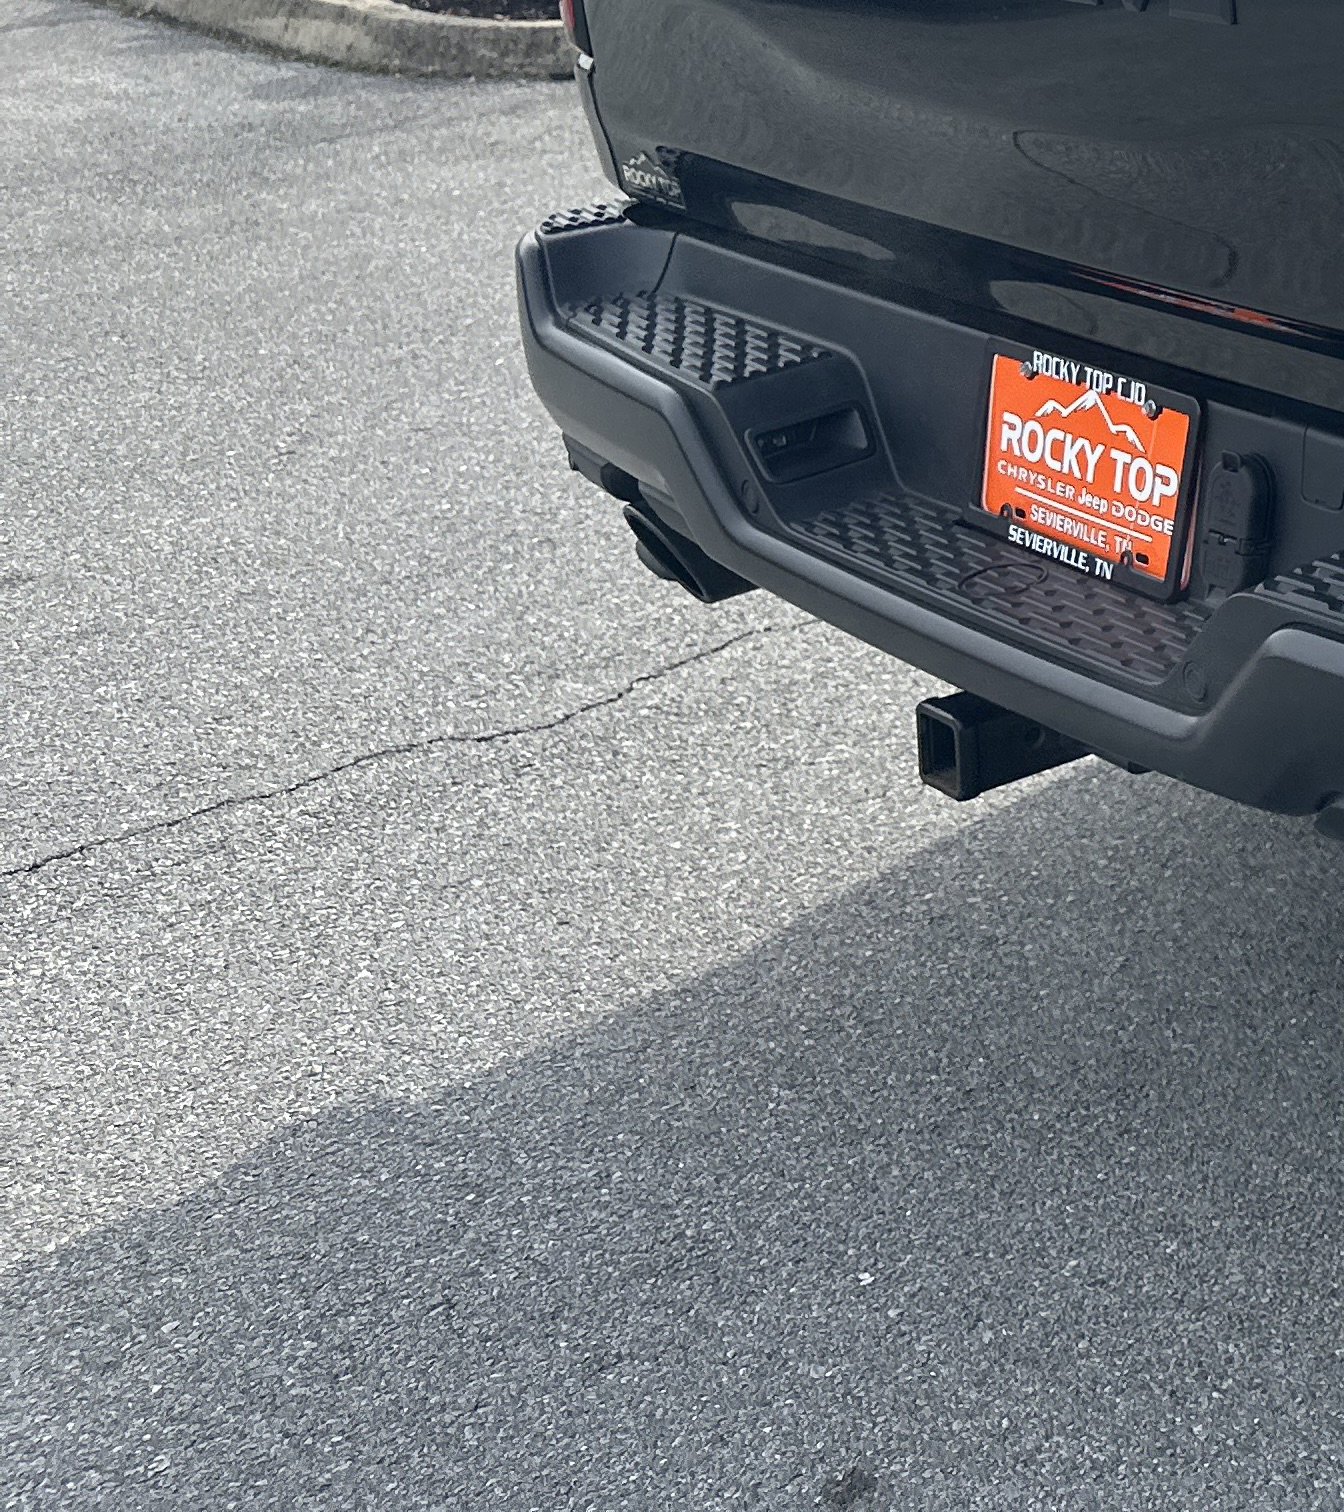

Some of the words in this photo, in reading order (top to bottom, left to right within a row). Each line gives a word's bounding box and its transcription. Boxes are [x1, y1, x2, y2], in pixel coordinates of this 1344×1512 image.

[1032, 350, 1081, 386] ROCKY
[1083, 366, 1113, 392] TOP
[1116, 376, 1147, 406] CJD
[1000, 411, 1106, 484] ROCKY
[1109, 448, 1180, 507] TOP
[996, 459, 1076, 502] CHRYSLER
[1077, 486, 1109, 515] Jeep
[1111, 500, 1176, 536] DODGE
[1007, 523, 1091, 573] SEVIERVILLE,
[1095, 559, 1114, 581] TN
[1029, 503, 1111, 554] SEVIERVILLE,
[1114, 535, 1134, 555] TN
